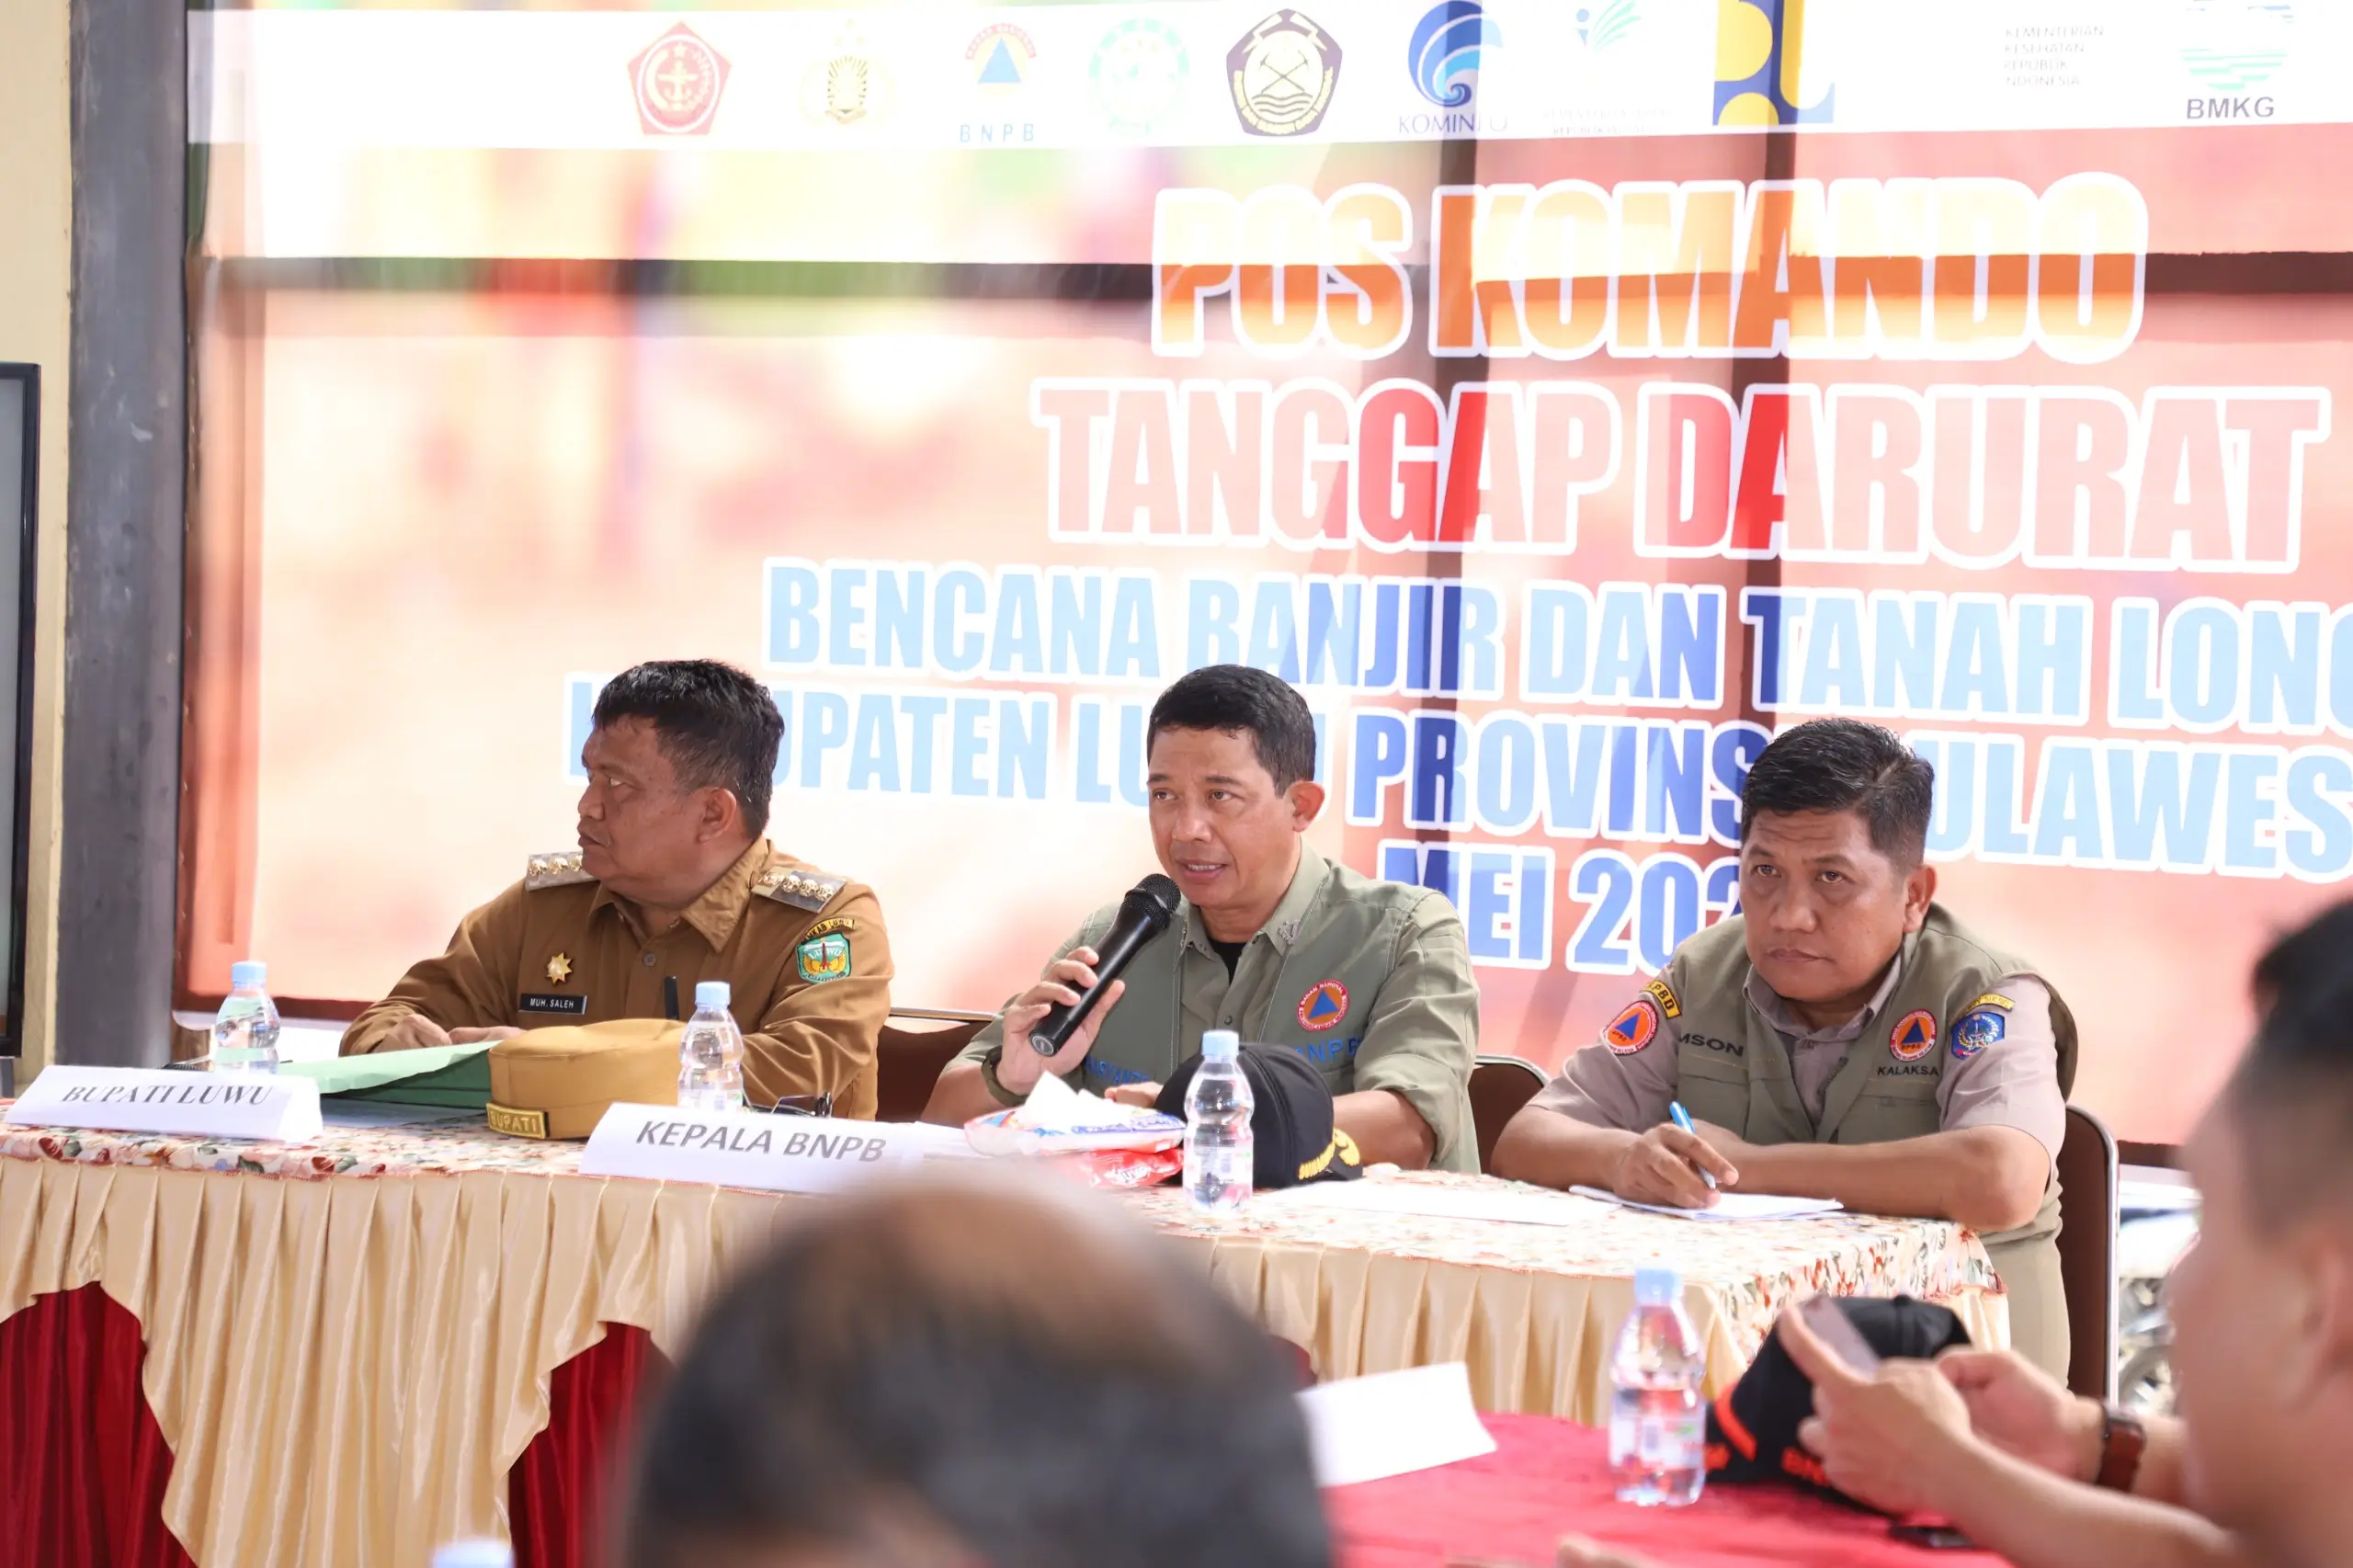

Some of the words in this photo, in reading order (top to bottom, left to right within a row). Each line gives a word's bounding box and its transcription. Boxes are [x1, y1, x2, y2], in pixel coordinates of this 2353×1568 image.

[2006, 75, 2082, 86] NDONESIA
[2186, 97, 2276, 119] BMKG
[959, 123, 1036, 143] BNPB
[1156, 187, 1409, 354] POS
[1433, 179, 2143, 357] KOMANDO
[1036, 383, 1617, 546] TANGGAP
[1642, 386, 2325, 564] DARURAT
[767, 563, 1164, 681] BENCANA
[1185, 576, 1503, 695] BANJIR
[1525, 585, 1722, 704] DAN
[1745, 591, 2087, 721] TANAH
[568, 679, 1051, 801] PATEN
[1349, 714, 1771, 840] PROVINS
[1912, 737, 2353, 876] ULAWES
[529, 997, 548, 1007] MUH.
[550, 999, 574, 1009] SALEH
[1877, 1065, 1940, 1077] KALAKSA
[62, 1085, 176, 1104] BUPATI
[176, 1085, 274, 1106] LUWU
[489, 1110, 538, 1133] BUPATI
[635, 1119, 774, 1155] KEPALA
[782, 1131, 888, 1164] BNPB
